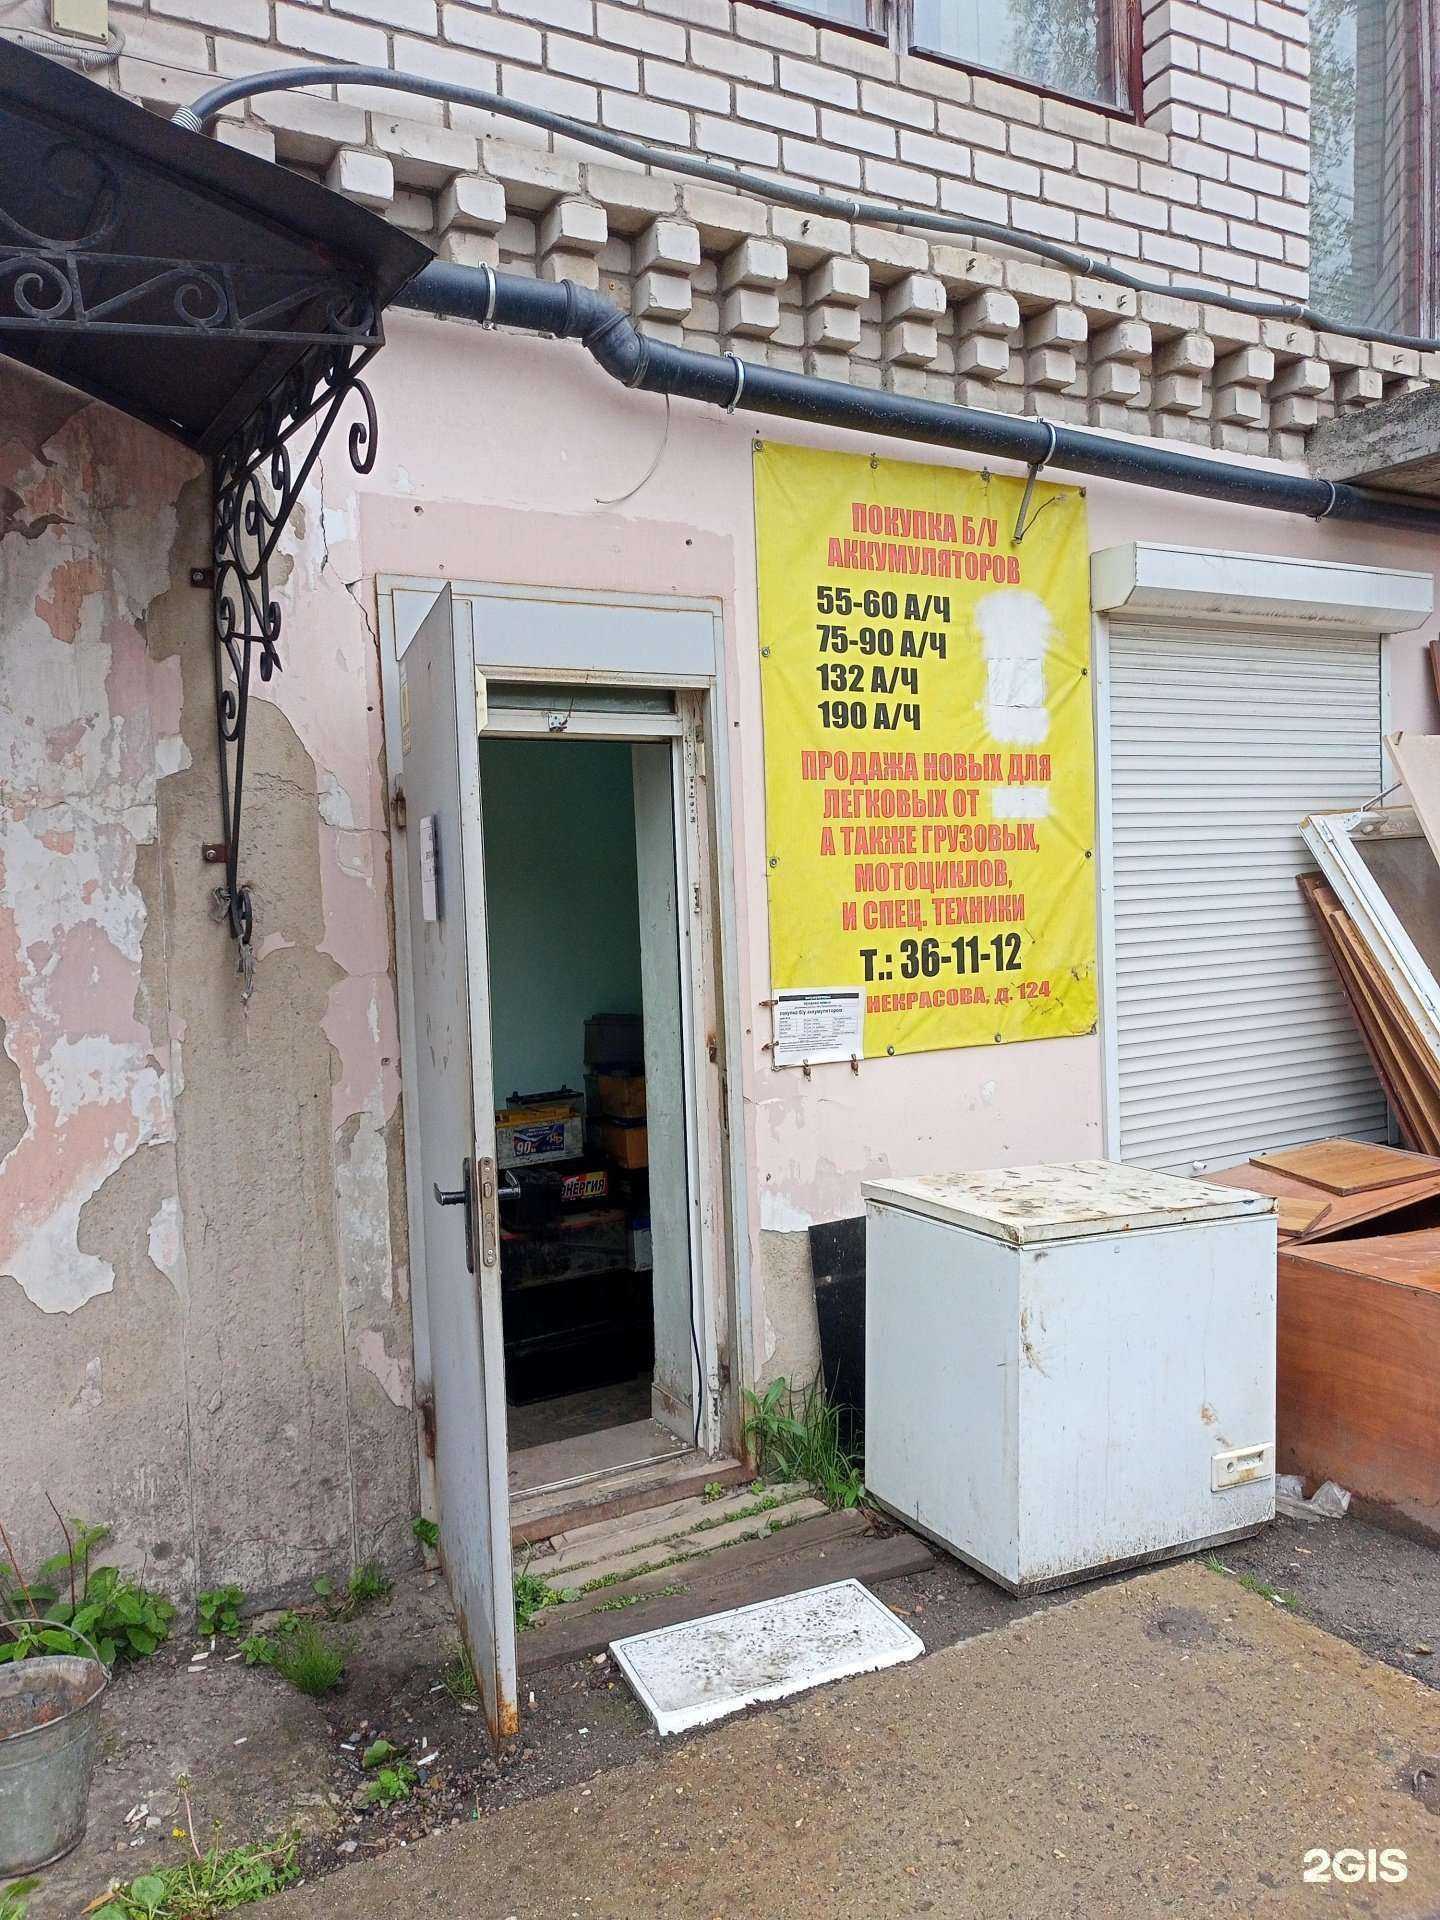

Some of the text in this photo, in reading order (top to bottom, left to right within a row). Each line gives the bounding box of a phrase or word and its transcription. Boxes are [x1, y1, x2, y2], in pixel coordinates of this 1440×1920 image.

[851, 502, 998, 547] ПОКУПКА Б/У
[827, 537, 1021, 584] АККУМУЛЯТОРОВ
[816, 586, 951, 623] 55-60 А/Ч
[816, 624, 947, 659] 75-90 А/Ч
[816, 664, 918, 695] 132 А/Ч
[817, 701, 921, 731] 190 А/Ч
[801, 750, 1051, 785] ПРОДАЖА НОВЫХ ДЛЯ
[823, 788, 980, 819] ЛЕГКОВЫХ ОТ
[820, 823, 1040, 856] А ТАКЖЕ ГРУЗОВЫХ,
[854, 859, 1013, 894] МОТОЦИКЛОВ,
[842, 893, 1026, 931] И СПЕЦ. ТЕХНИКИ
[900, 932, 1022, 980] 36-11-12
[866, 985, 991, 1014] НЕКРАСОВА,
[1018, 980, 1051, 1000] 124
